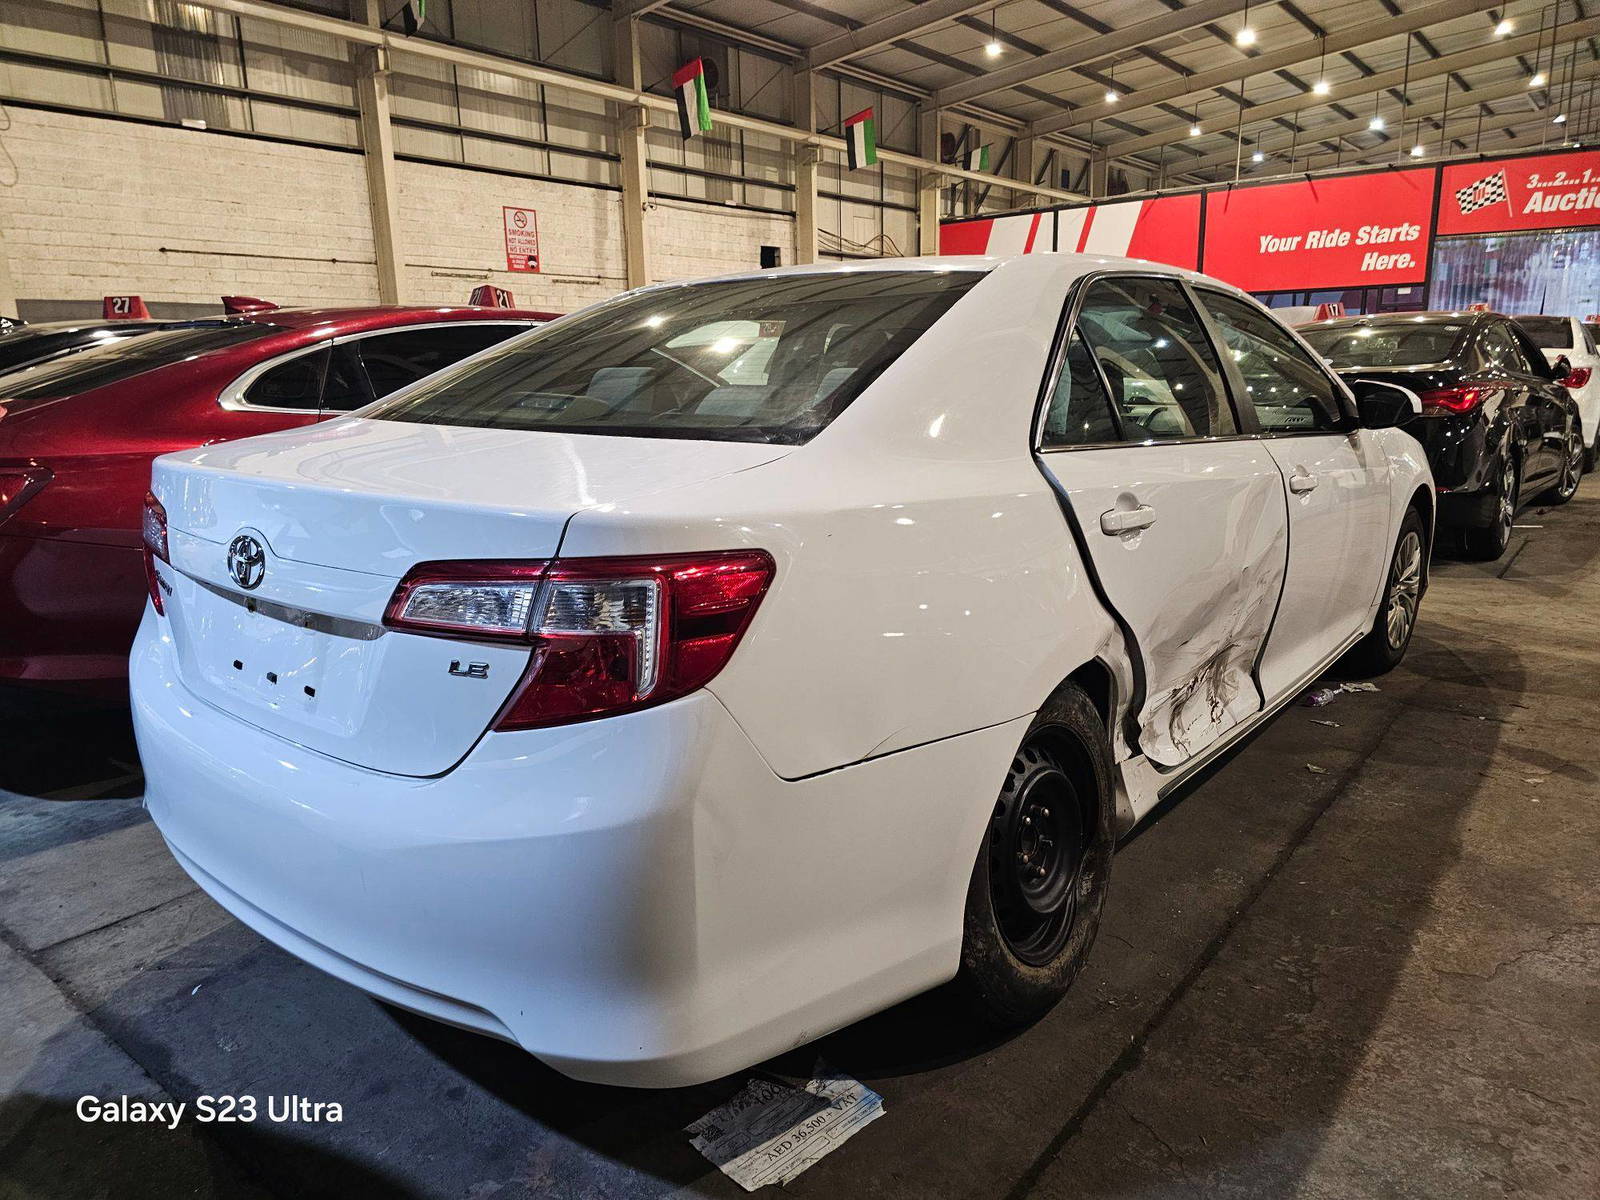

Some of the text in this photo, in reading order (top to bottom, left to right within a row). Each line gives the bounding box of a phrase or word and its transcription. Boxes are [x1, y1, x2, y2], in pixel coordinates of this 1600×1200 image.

[508, 228, 536, 238] SMOKING
[1259, 222, 1421, 253] Your Ride Starts
[1360, 252, 1416, 272] Here.
[112, 297, 130, 314] 27
[496, 289, 510, 309] 21
[1328, 303, 1339, 316] 17
[448, 659, 490, 680] LE
[766, 1139, 793, 1163] AED
[831, 1092, 860, 1112] VAT
